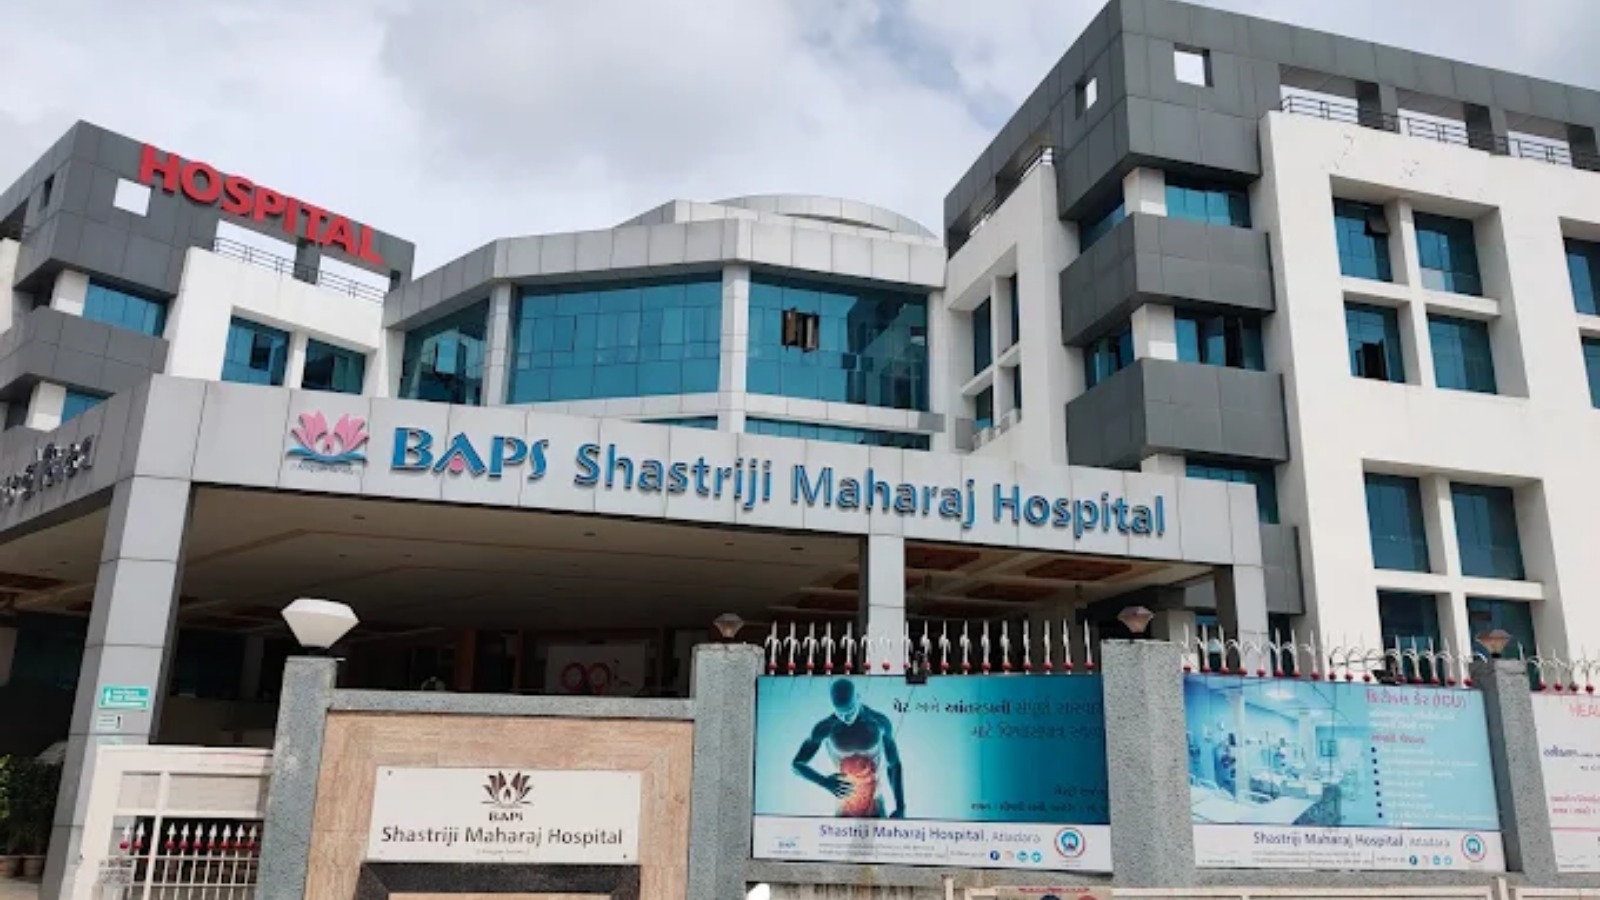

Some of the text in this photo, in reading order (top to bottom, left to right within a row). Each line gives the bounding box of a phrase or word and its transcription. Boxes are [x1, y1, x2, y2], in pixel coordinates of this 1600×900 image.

[139, 143, 386, 265] HOSPITAL
[391, 426, 1165, 539] BAPS Shastriji Maharaj Hospital
[381, 826, 623, 848] Shastriji Maharaj Hospital
[820, 824, 869, 840] Shastriji
[873, 826, 926, 842] Maharaj
[1253, 831, 1301, 847] Shastriji
[1305, 833, 1353, 849] Maharaj
